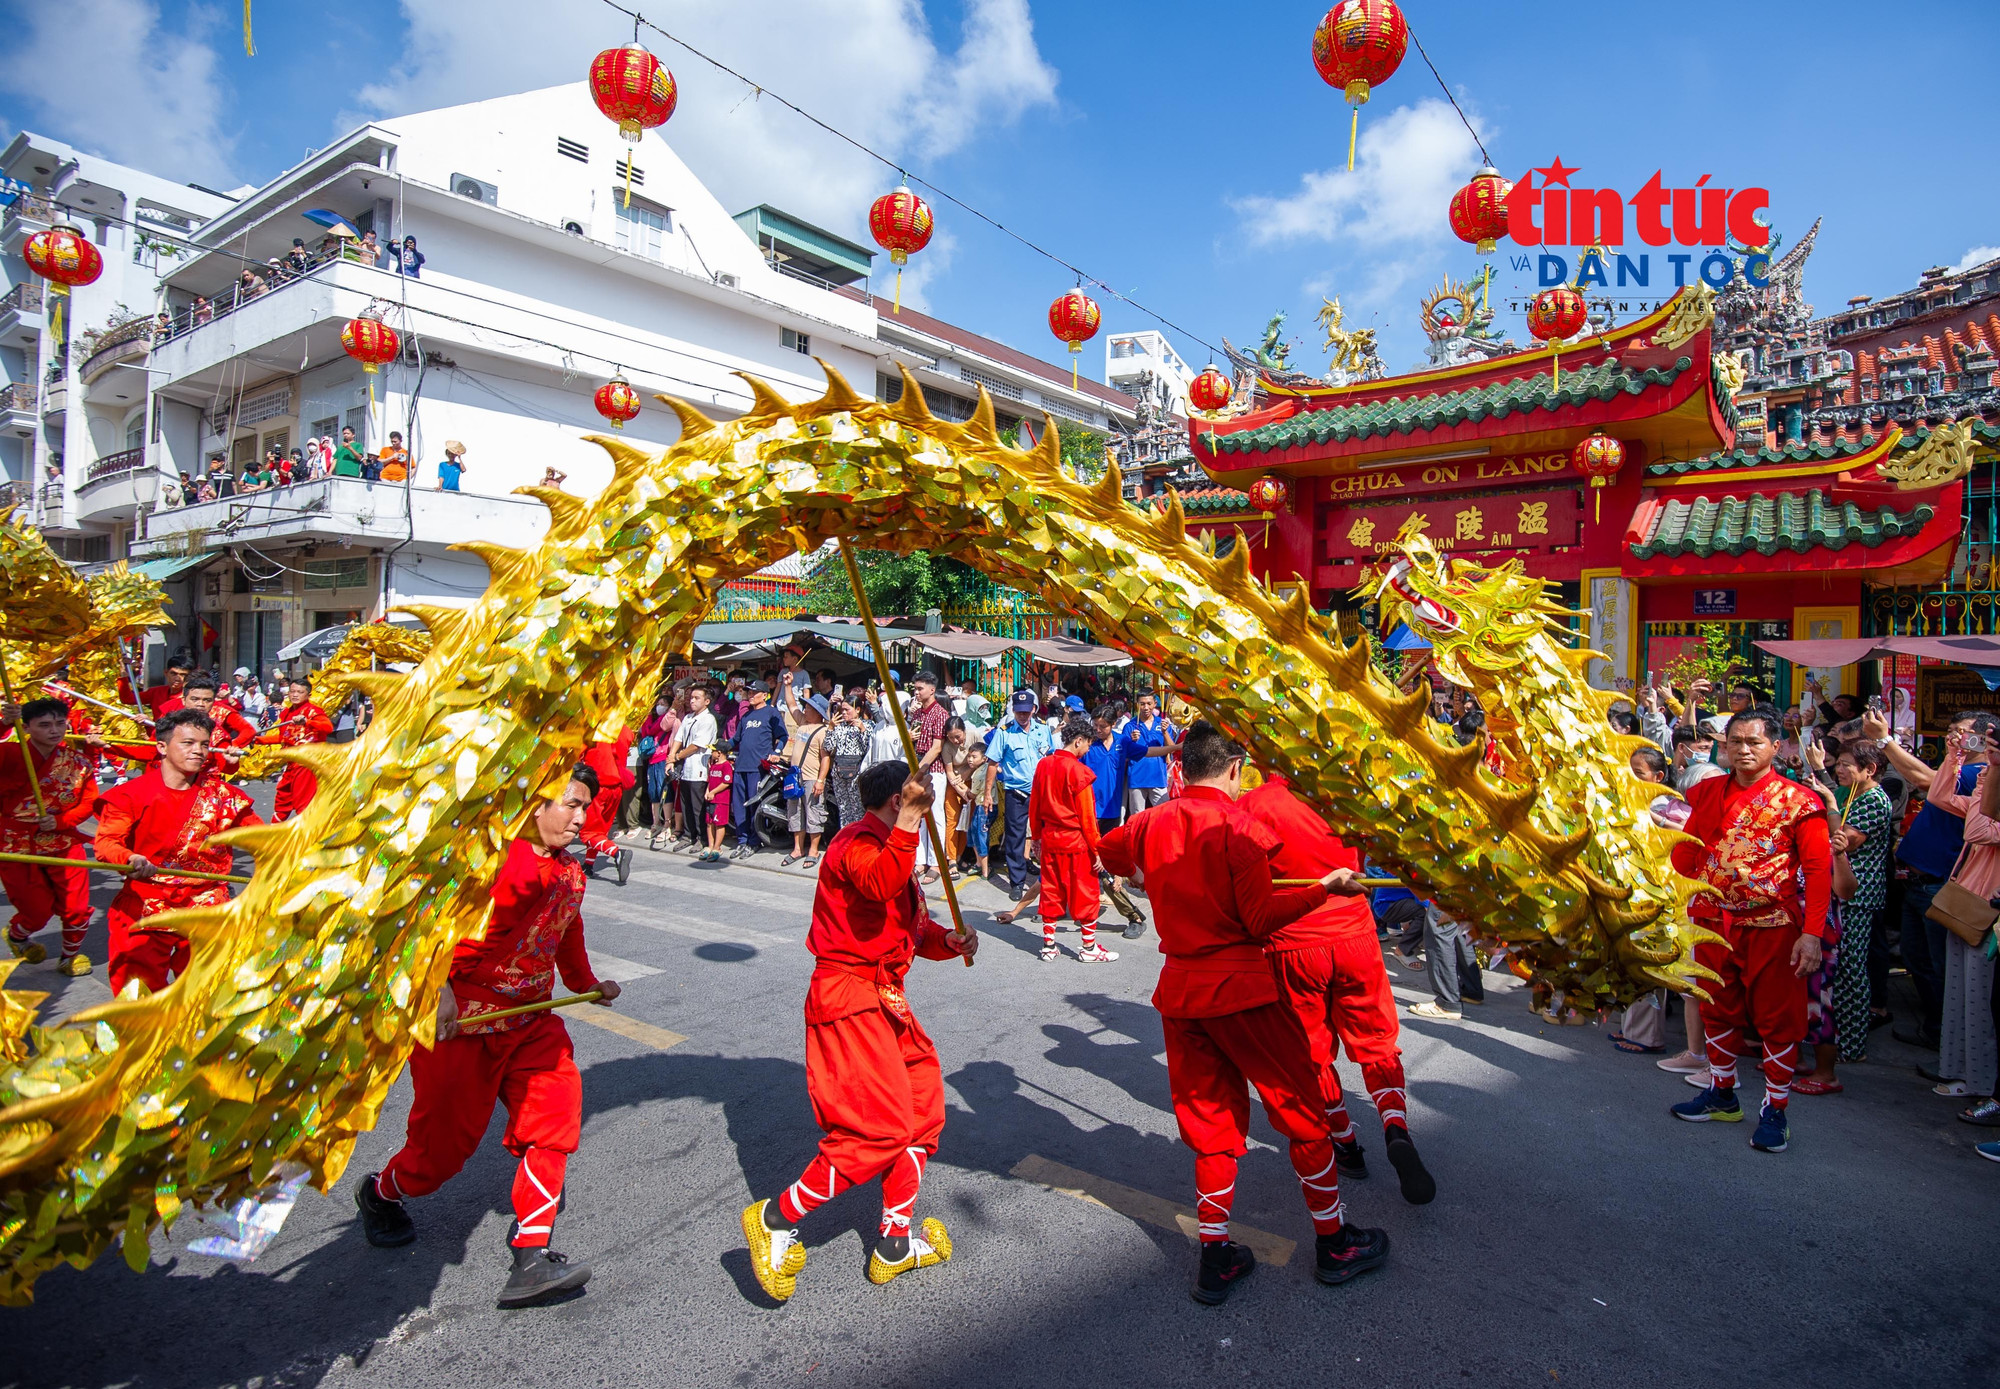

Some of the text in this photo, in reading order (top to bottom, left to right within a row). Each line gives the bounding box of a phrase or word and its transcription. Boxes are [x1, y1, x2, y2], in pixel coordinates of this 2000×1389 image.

[1330, 471, 1405, 493] CHÙA
[1476, 453, 1569, 480] LĂNG
[1429, 537, 1454, 550] UAN
[1491, 532, 1512, 546] ÂM
[1702, 591, 1727, 605] 12
